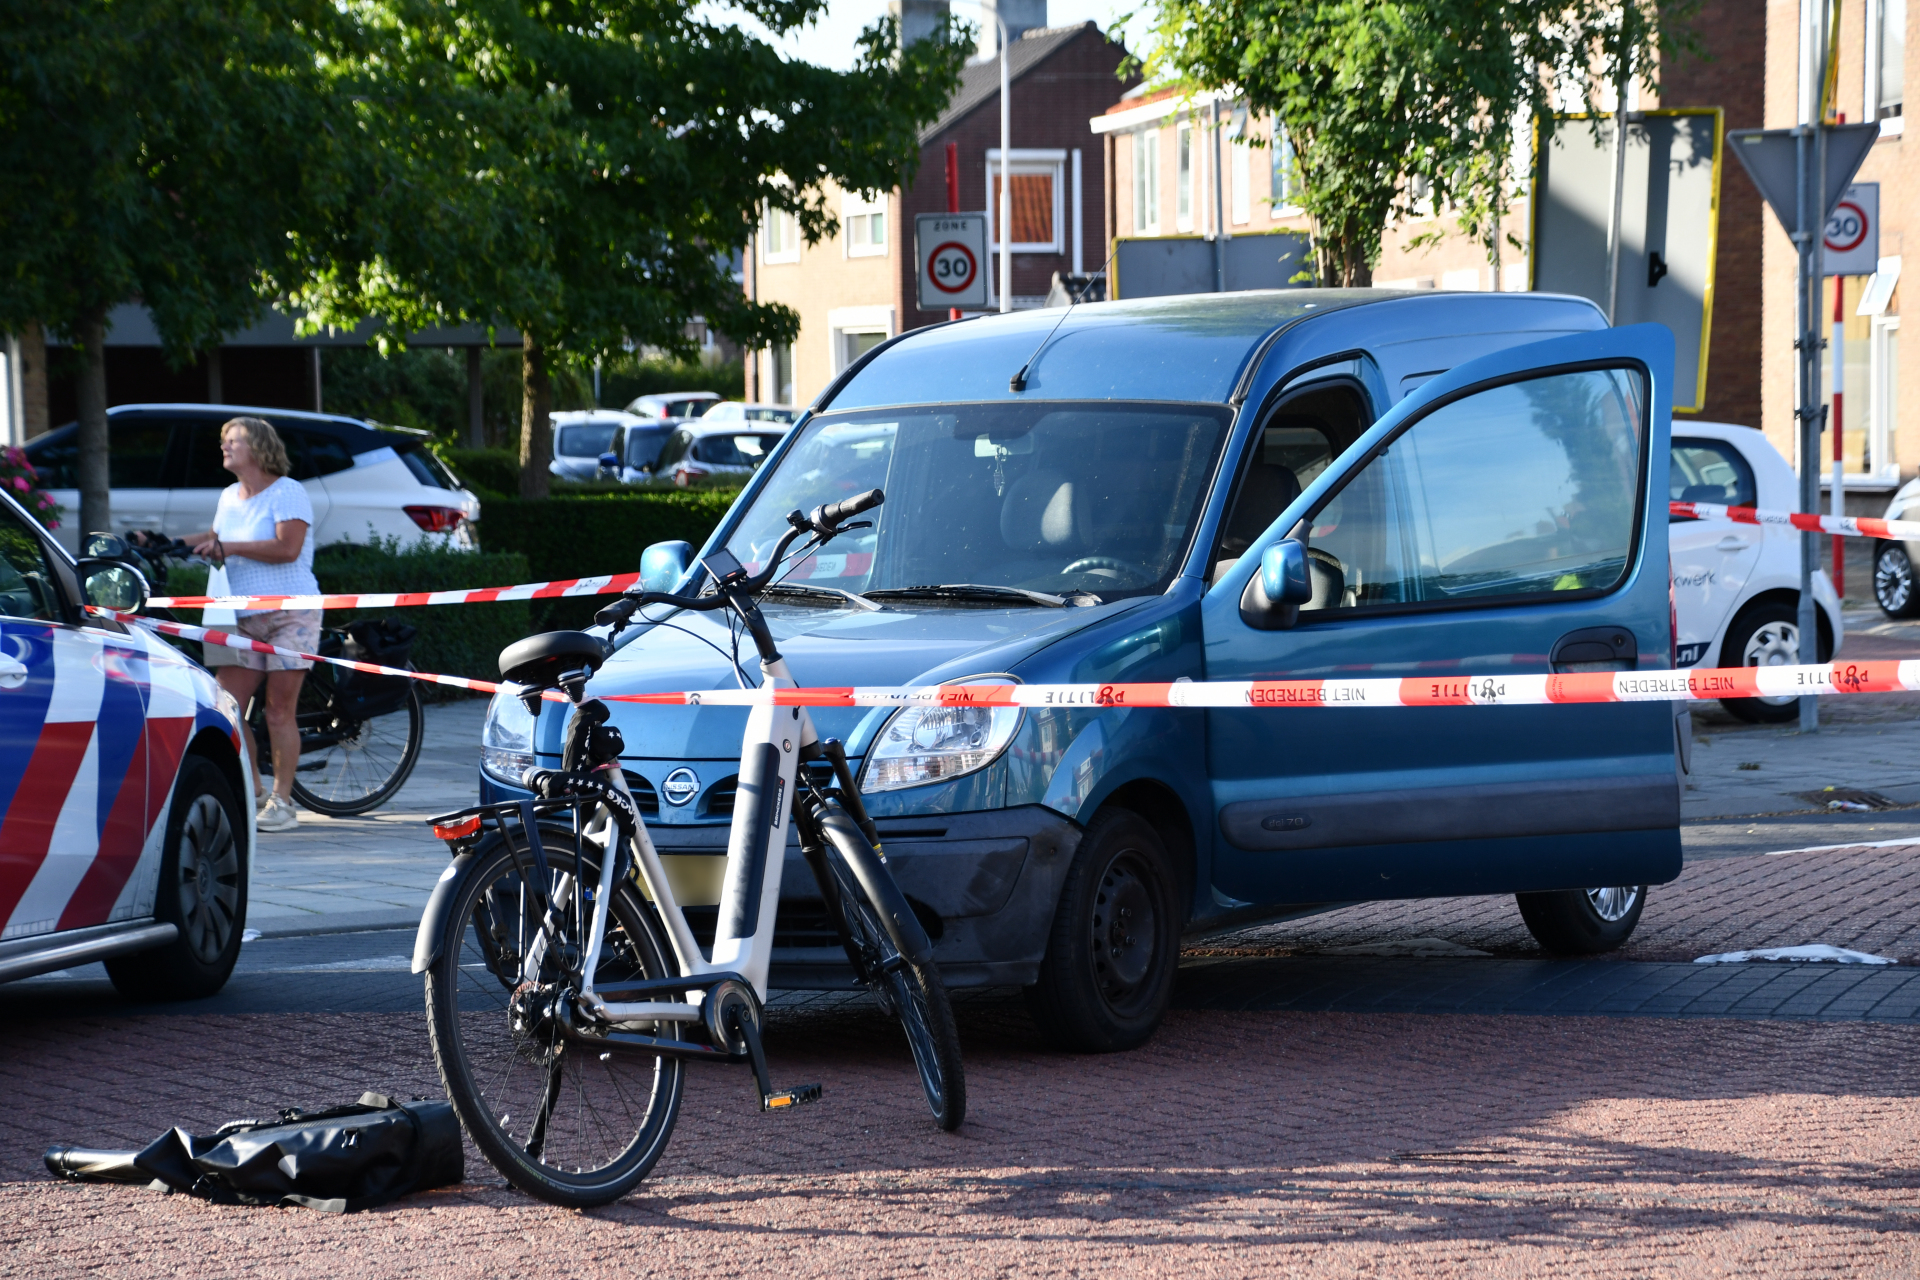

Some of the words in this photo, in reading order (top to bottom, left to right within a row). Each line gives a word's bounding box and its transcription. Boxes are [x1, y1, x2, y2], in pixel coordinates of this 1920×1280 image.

[933, 221, 968, 231] ZONE
[1827, 216, 1858, 238] 30
[937, 257, 968, 278] 30
[1619, 678, 1698, 694] BETREDEN
[1702, 677, 1735, 691] NIET
[1244, 688, 1327, 703] BETREDEN
[1332, 687, 1366, 701] NIET
[663, 783, 695, 791] NISSAN
[1286, 817, 1304, 826] 70
